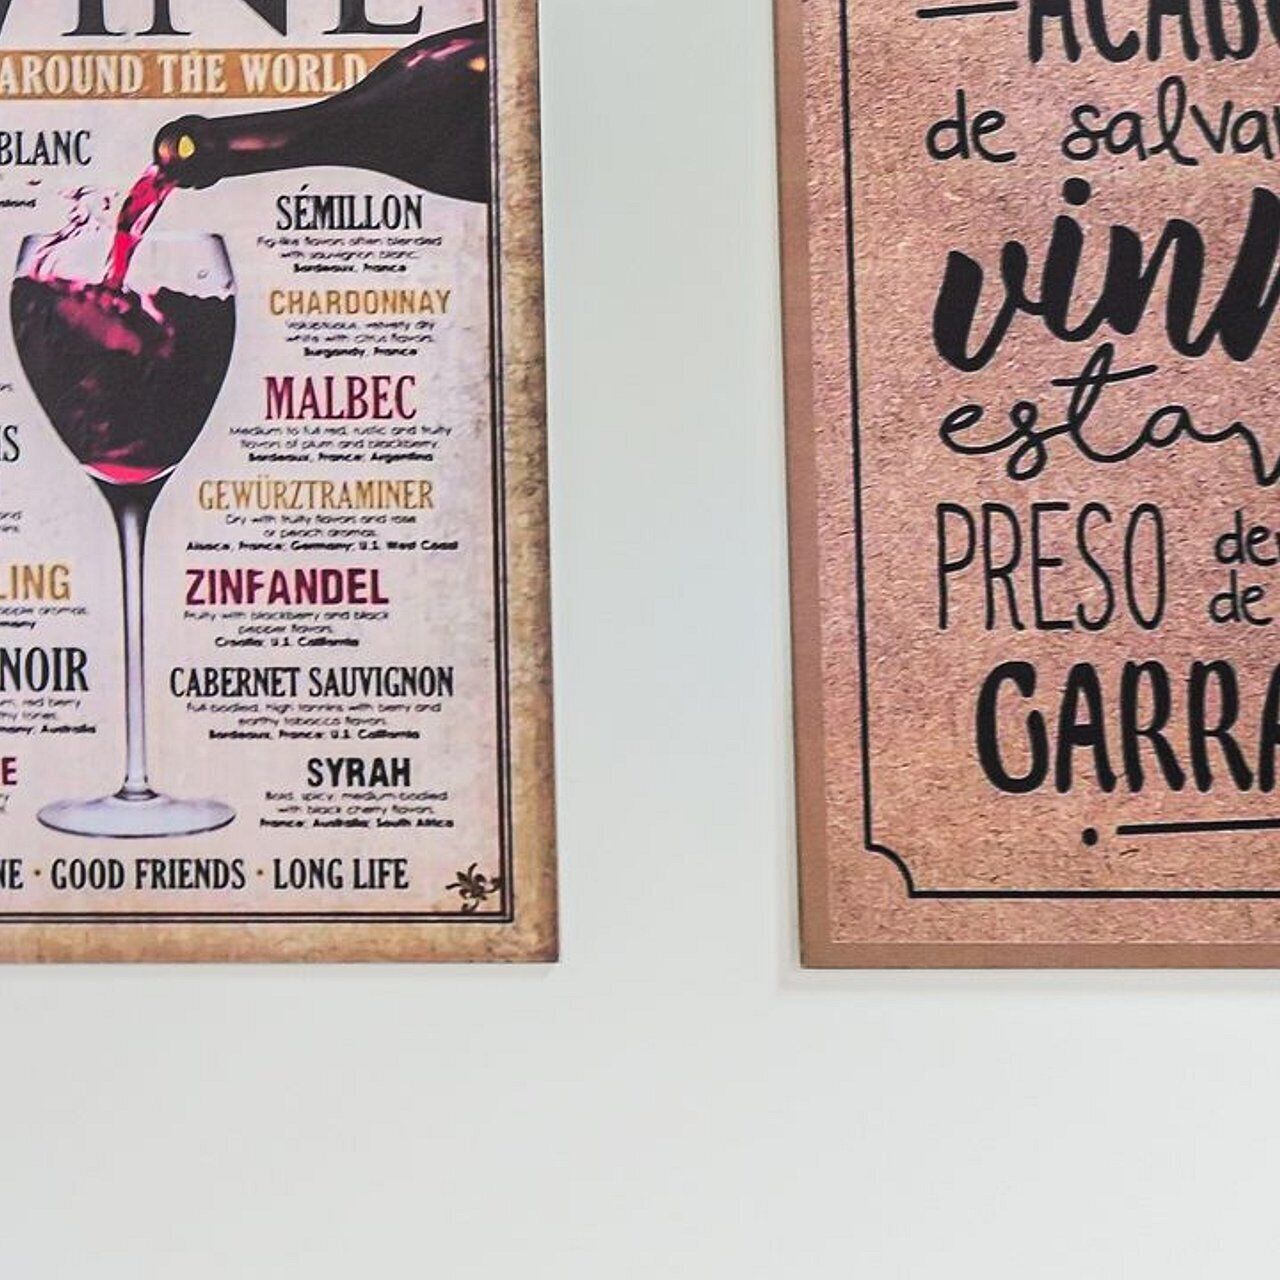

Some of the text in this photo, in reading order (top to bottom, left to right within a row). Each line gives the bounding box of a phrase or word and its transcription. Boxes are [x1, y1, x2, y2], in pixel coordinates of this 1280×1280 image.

[157, 53, 226, 95] THE
[240, 52, 368, 95] WORLD
[925, 75, 1280, 166] de salva
[276, 184, 423, 230] SÉMILLON
[270, 290, 450, 315] CHARDONNAY
[266, 376, 416, 420] MALBEC
[199, 476, 433, 510] GEWÜRZTRAMINER
[186, 568, 389, 605] ZINFANDEL
[936, 502, 1280, 631] PRESO de
[1206, 568, 1273, 626] de
[0, 647, 88, 692] NOIR
[170, 667, 453, 697] CABERNET SAUVIGNON
[308, 757, 410, 787] SYRAH
[51, 859, 124, 889] GOOD
[135, 859, 245, 889] FRIENDS
[274, 859, 343, 889] LONG
[353, 859, 409, 889] LIFE
